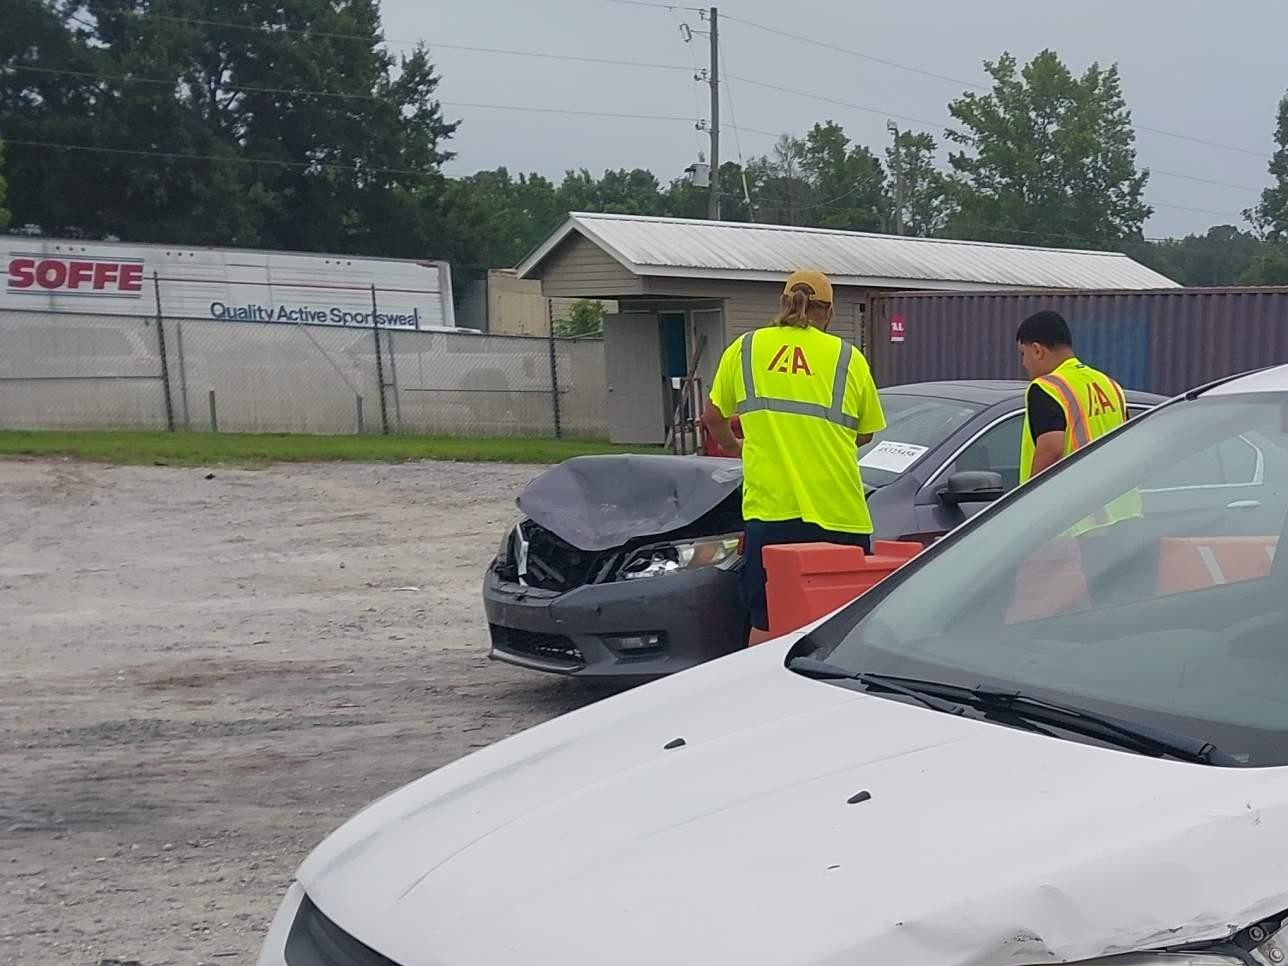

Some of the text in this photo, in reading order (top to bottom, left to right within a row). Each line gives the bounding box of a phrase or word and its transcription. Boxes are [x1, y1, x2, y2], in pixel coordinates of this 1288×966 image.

[8, 258, 144, 291] SOFFE
[210, 302, 421, 328] Quality Active Sportswea
